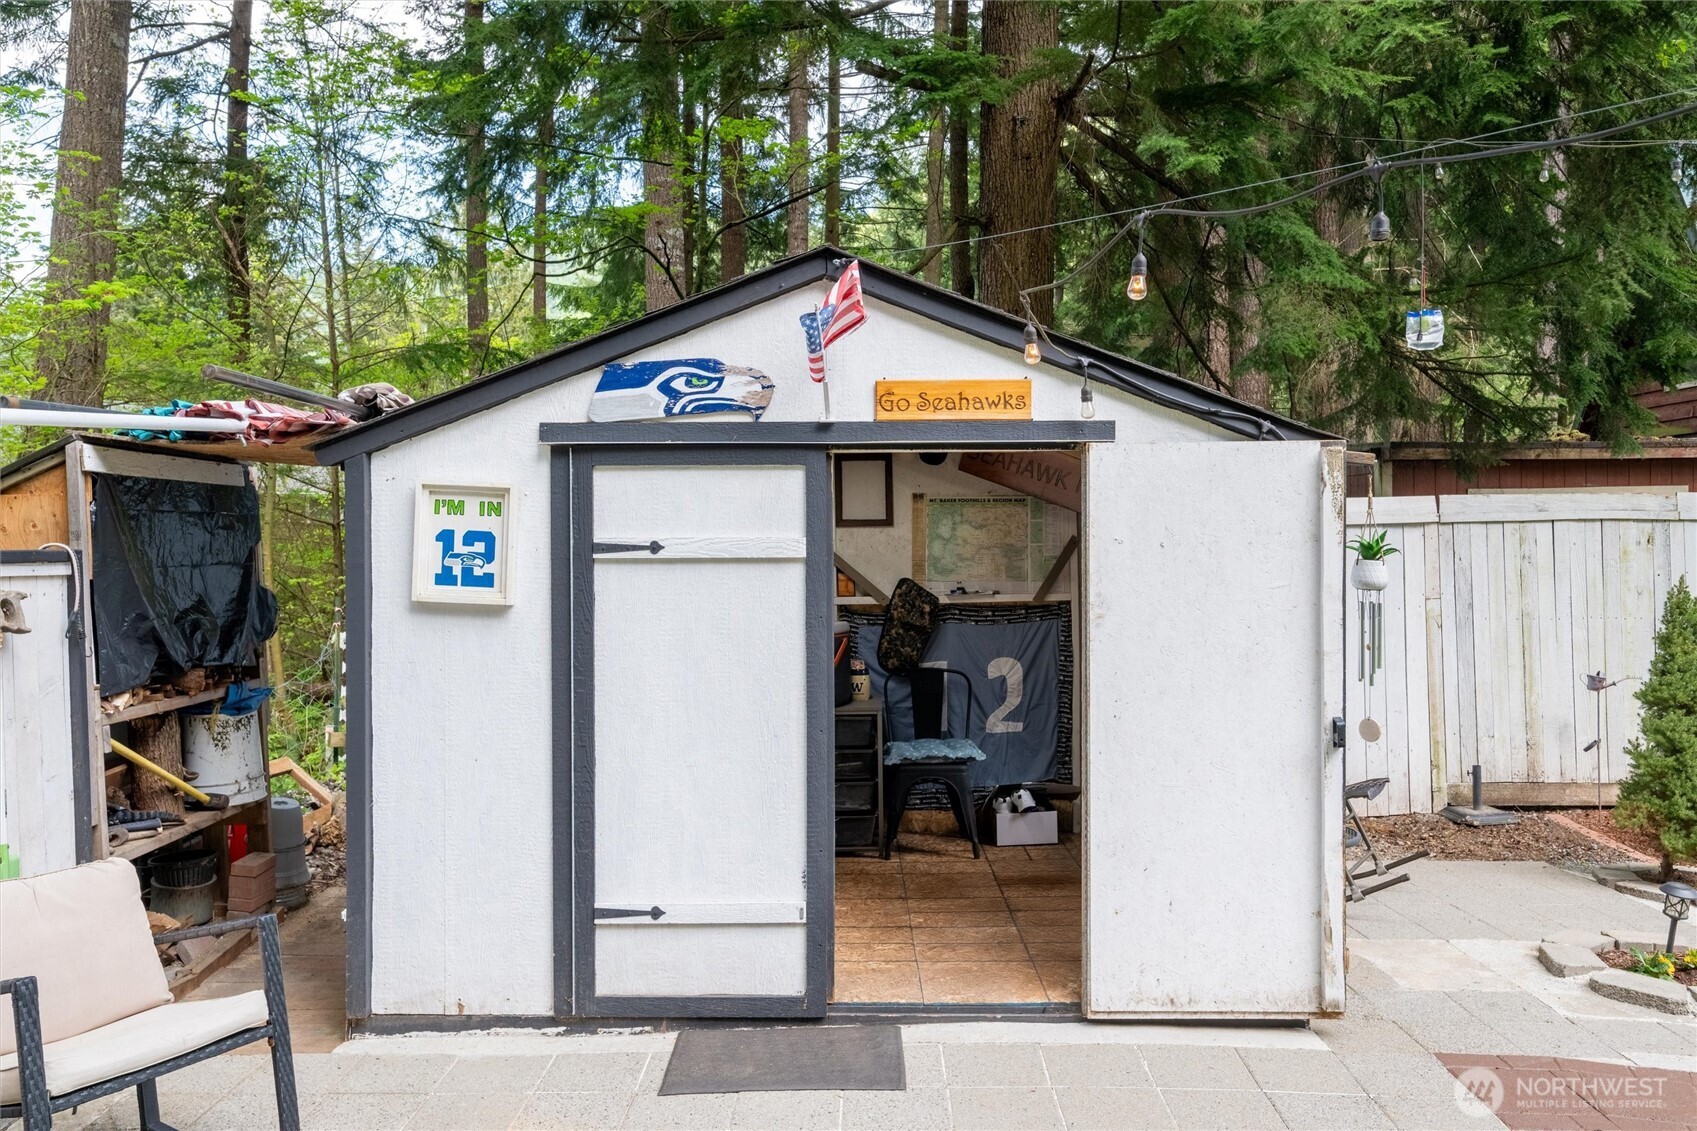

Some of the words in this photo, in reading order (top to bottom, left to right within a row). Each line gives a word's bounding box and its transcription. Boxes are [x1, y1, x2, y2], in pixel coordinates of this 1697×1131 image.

[878, 391, 910, 412] Go
[916, 391, 1027, 413] Seahawks
[433, 498, 465, 516] I'M
[479, 500, 502, 517] IN
[434, 528, 496, 588] 12
[851, 682, 864, 693] W
